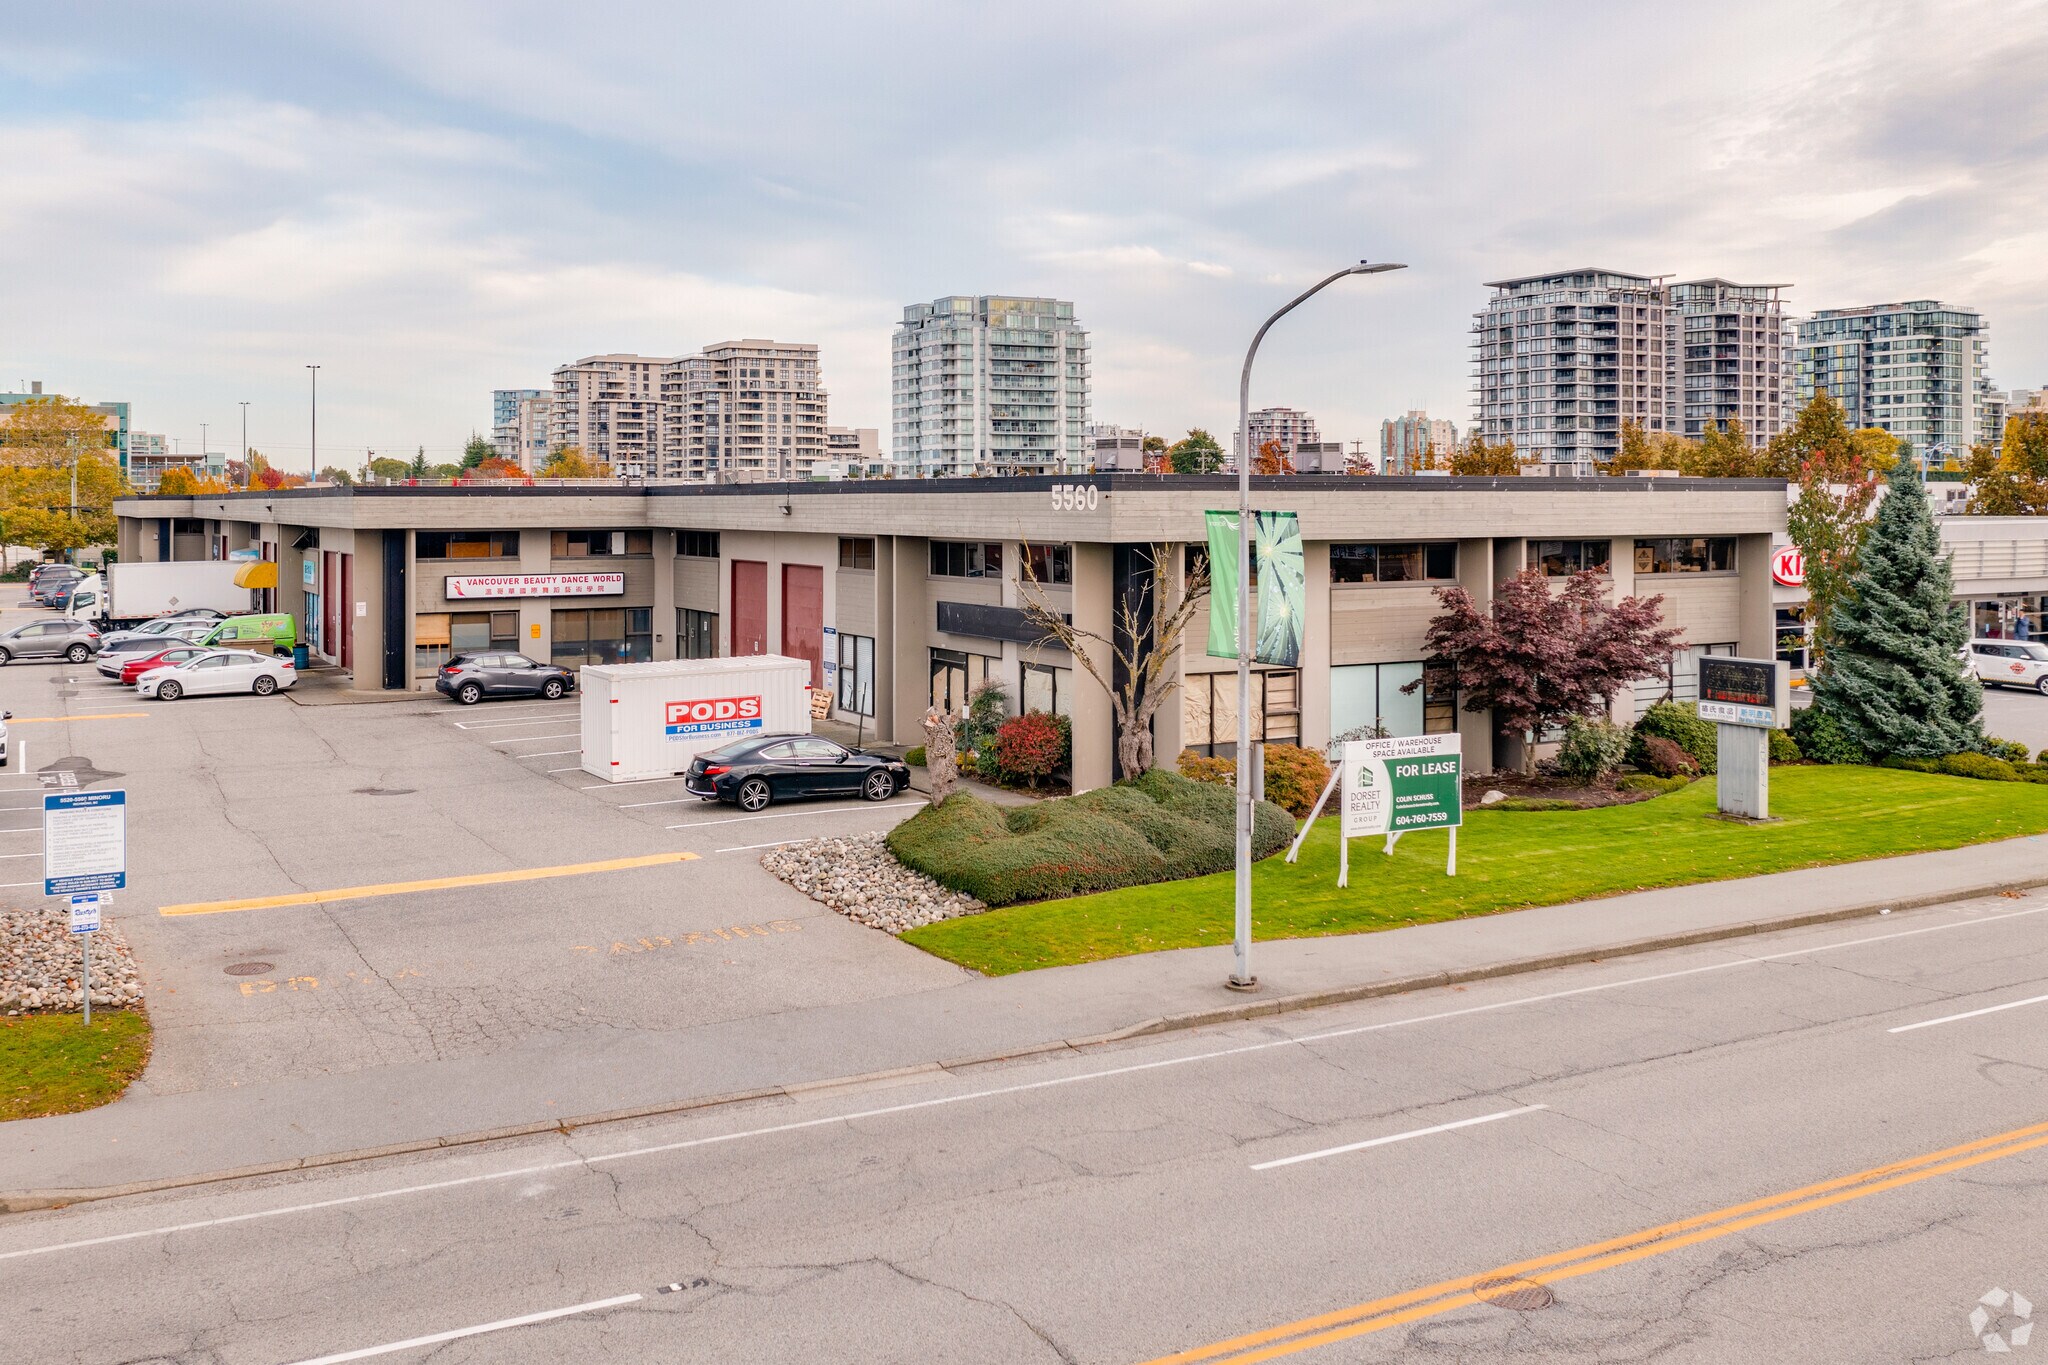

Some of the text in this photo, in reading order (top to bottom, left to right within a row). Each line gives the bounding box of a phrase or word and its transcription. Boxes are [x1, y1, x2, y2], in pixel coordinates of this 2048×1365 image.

[1051, 484, 1098, 511] 5560
[1781, 555, 1806, 576] KI
[466, 574, 622, 586] VANCOUVER BEAUTY DANCE WORLD
[668, 699, 759, 722] PODS
[677, 720, 751, 733] FOR BUSINESS
[1365, 741, 1391, 750] OFFICE
[1397, 737, 1442, 747] WAREHOUSE
[1373, 746, 1435, 758] SPACE AVAILABLE
[1396, 761, 1457, 778] FOR LEASE
[1350, 790, 1381, 802] DORSET
[1396, 793, 1434, 803] COLIN SCHUSS
[1350, 800, 1381, 812] REALTY
[1353, 815, 1378, 823] GROUP
[1396, 812, 1448, 826] 604-760-7559
